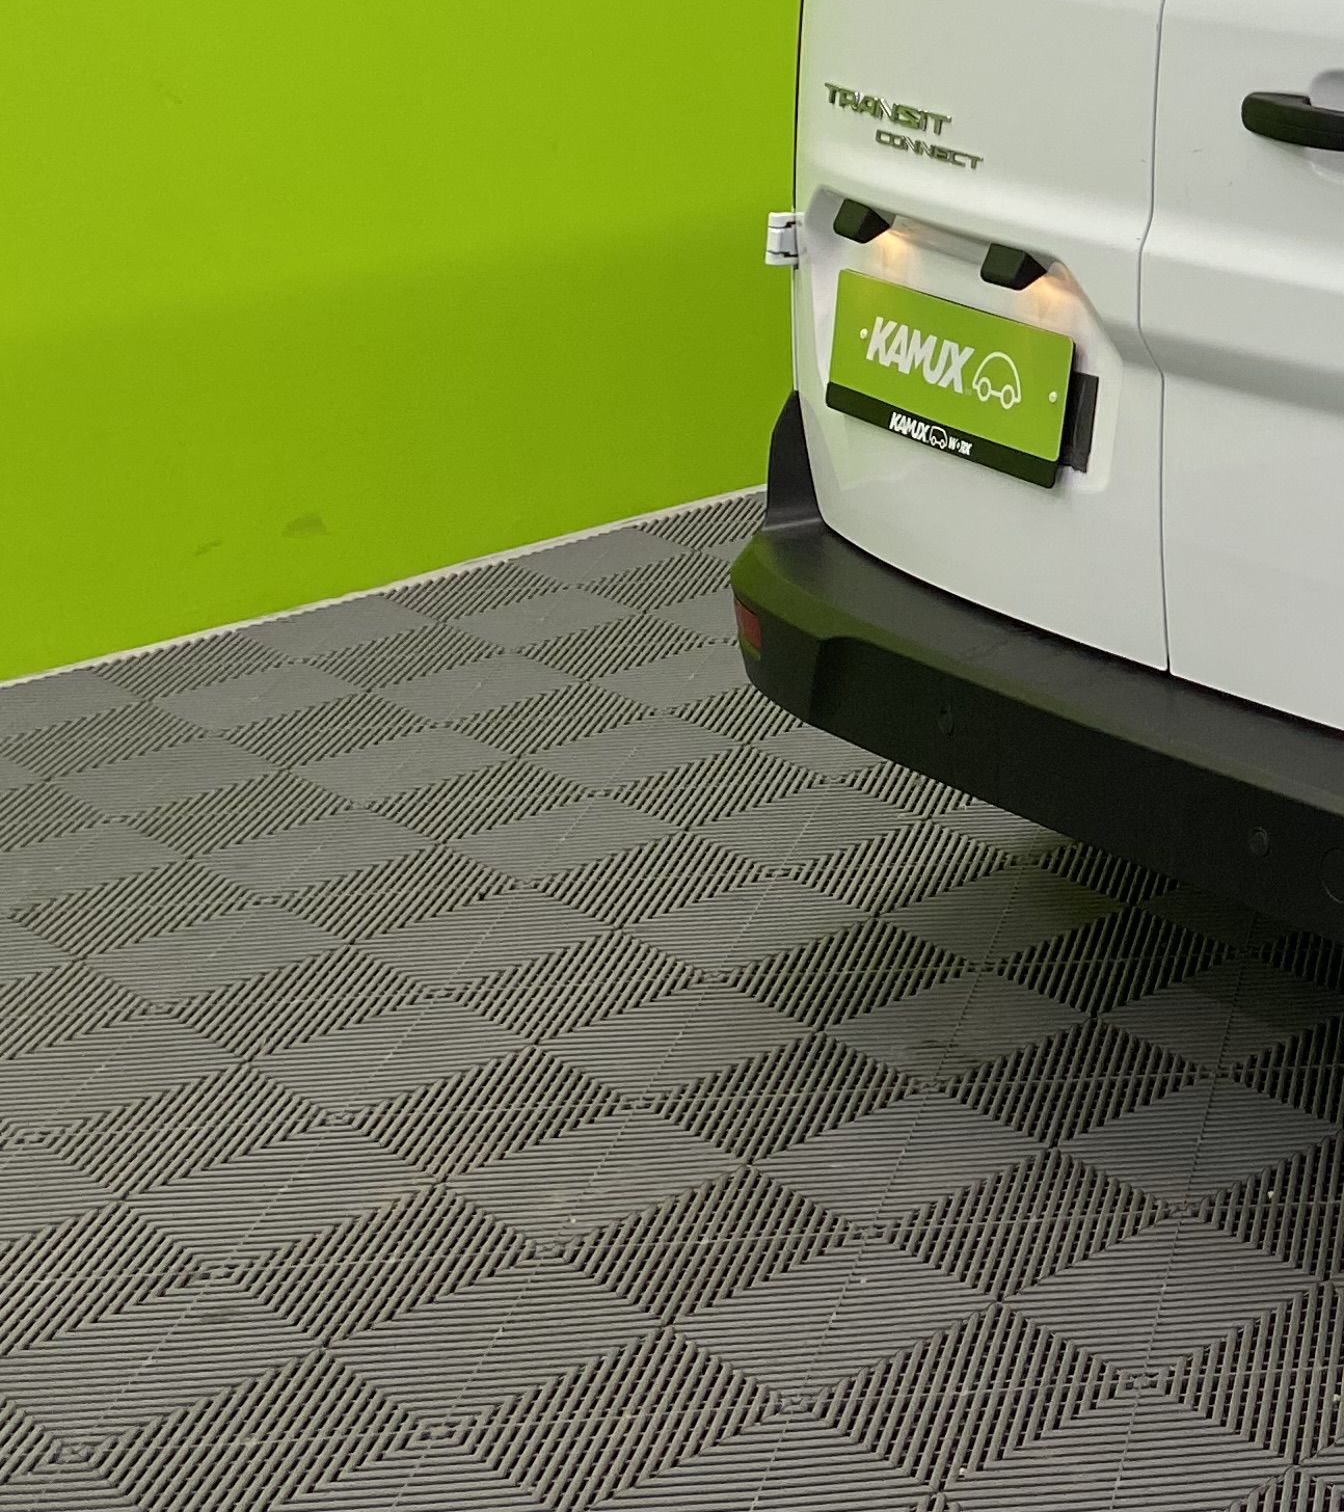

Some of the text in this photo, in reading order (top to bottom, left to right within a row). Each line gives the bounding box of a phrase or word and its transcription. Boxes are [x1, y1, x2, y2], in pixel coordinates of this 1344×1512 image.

[824, 82, 952, 136] TRANSIT
[875, 129, 984, 170] CONNECT
[866, 316, 975, 394] KAMUX
[889, 411, 930, 443] KAMUX
